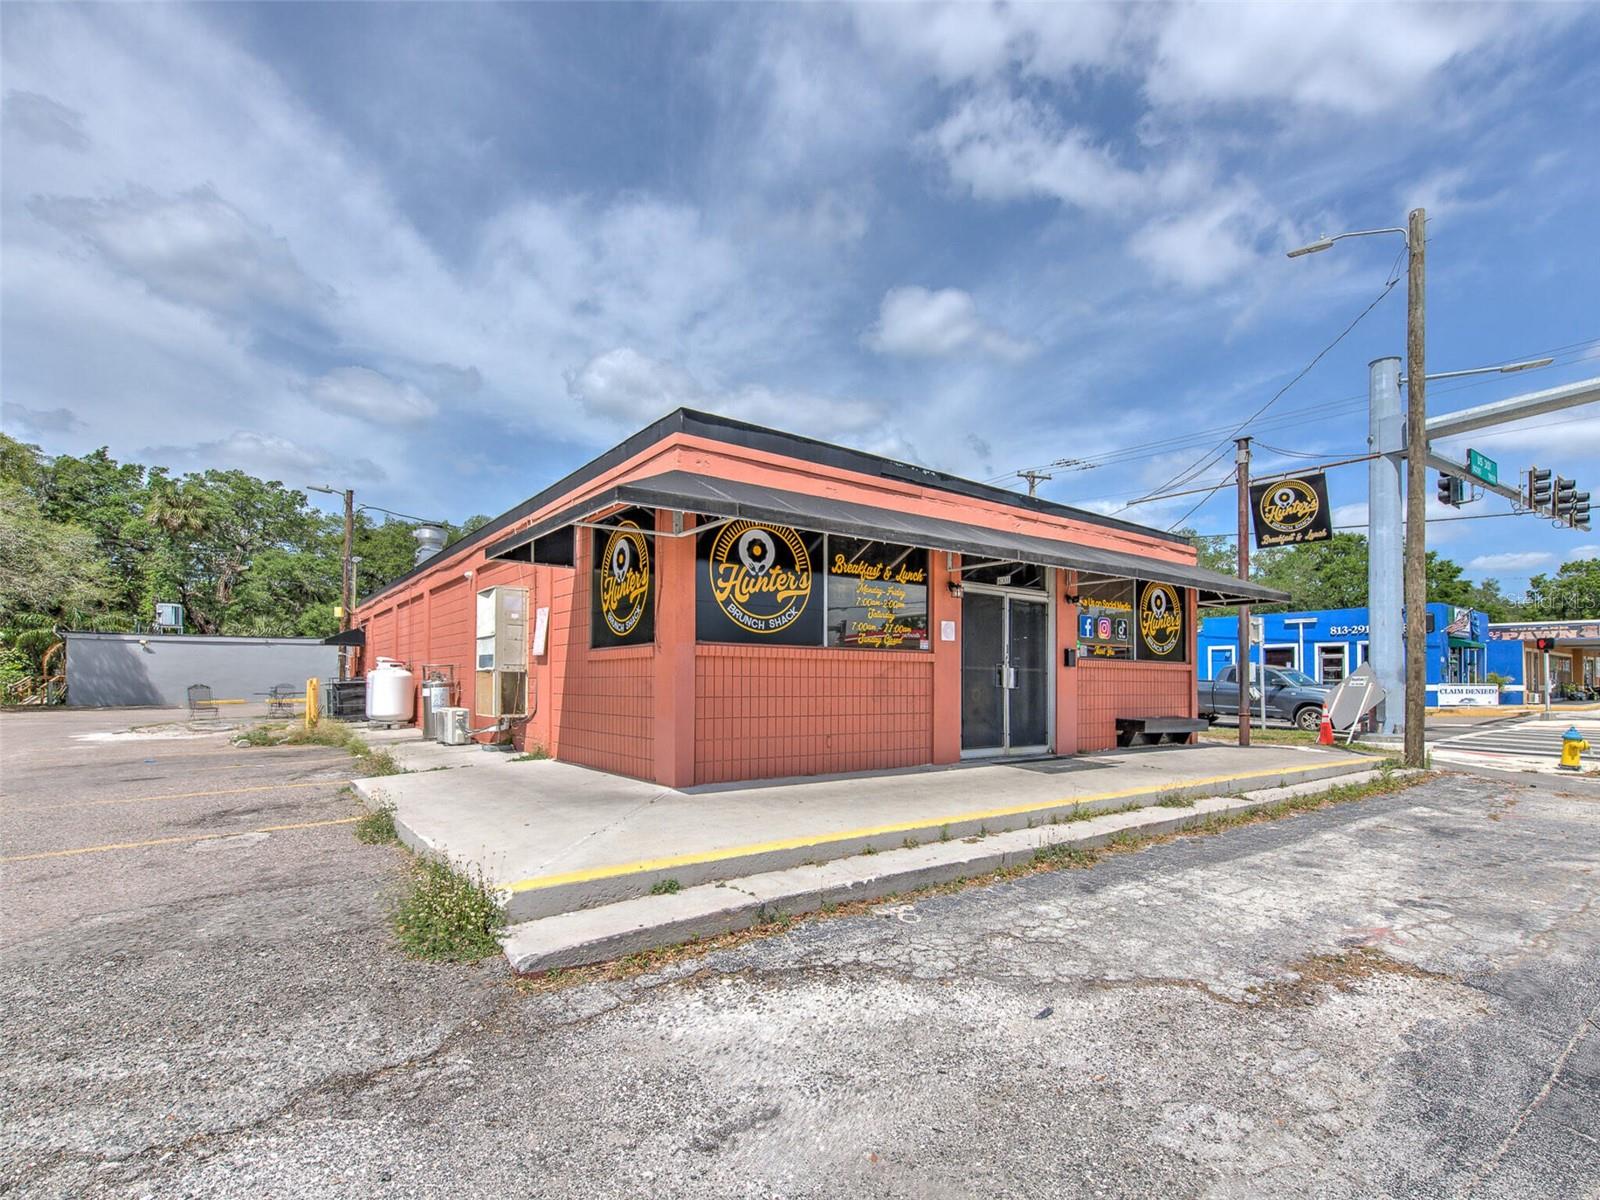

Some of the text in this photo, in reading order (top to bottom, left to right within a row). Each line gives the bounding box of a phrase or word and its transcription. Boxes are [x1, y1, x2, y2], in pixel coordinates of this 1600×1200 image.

[1261, 533, 1296, 545] Breakfast
[1305, 528, 1327, 540] Lunch
[832, 554, 927, 584] Breakfast & Lunch
[727, 604, 798, 630] BRUNCH SHACK
[1502, 629, 1578, 640] PAWN
